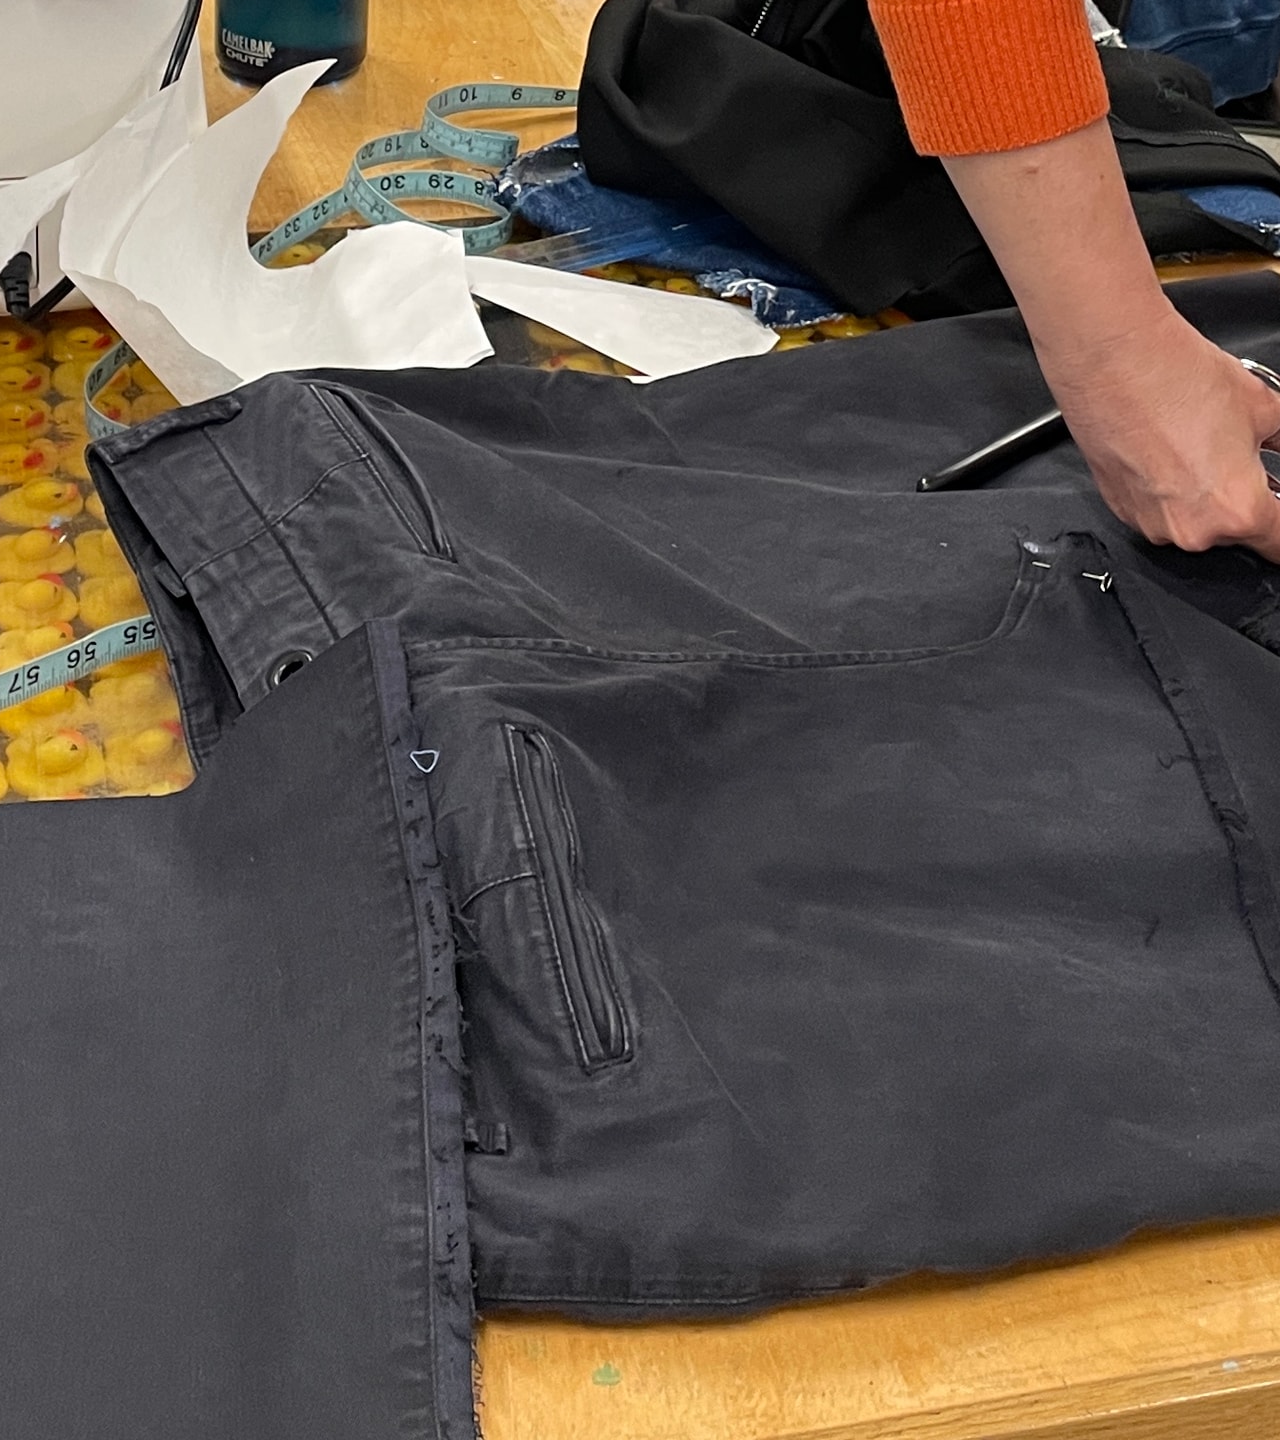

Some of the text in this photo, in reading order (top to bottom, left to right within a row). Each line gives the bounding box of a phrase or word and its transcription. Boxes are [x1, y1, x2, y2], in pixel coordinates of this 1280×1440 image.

[222, 28, 272, 59] CAMELBAK
[225, 48, 265, 68] CHUTE
[459, 87, 478, 102] 10
[554, 89, 567, 101] 8
[380, 175, 406, 191] 30
[428, 174, 455, 190] 29
[284, 217, 301, 239] 33
[123, 620, 157, 644] 55
[66, 641, 98, 668] 56
[8, 665, 41, 694] 57
